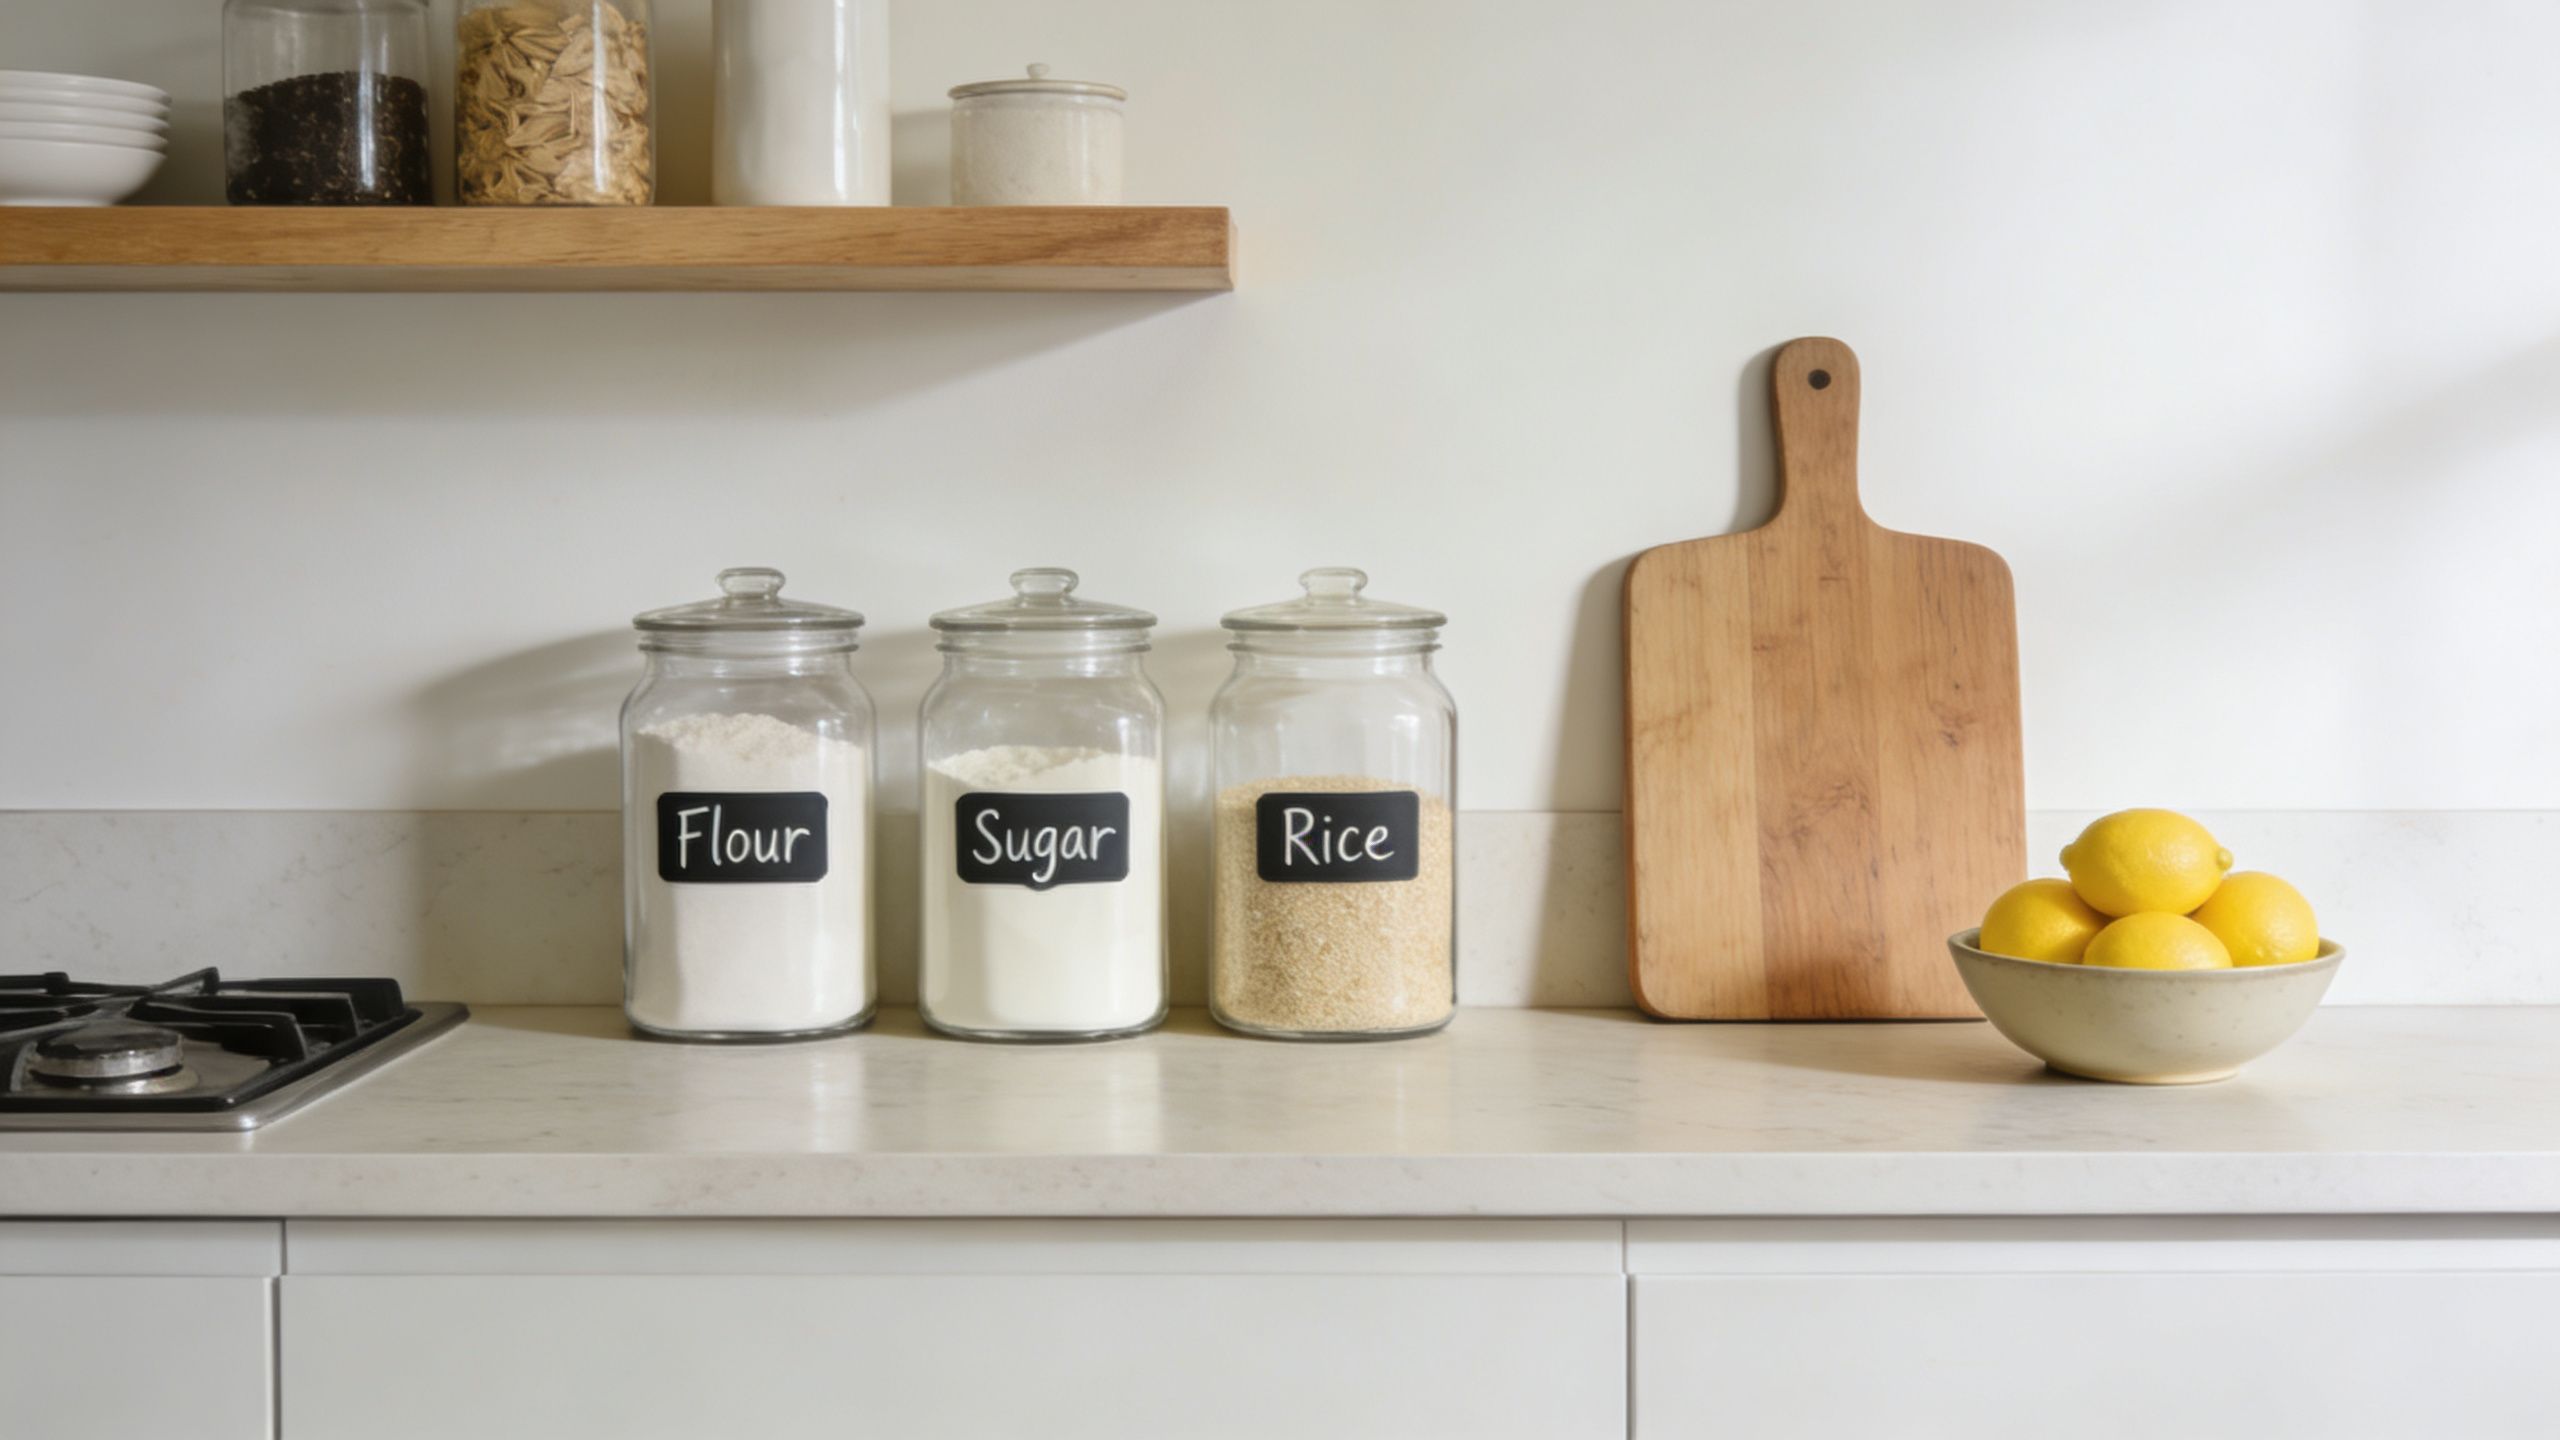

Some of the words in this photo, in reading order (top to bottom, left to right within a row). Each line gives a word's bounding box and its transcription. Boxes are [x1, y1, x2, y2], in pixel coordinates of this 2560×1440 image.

[677, 804, 811, 868] Flour
[972, 808, 1117, 884] Sugar
[1283, 807, 1395, 866] Rice
